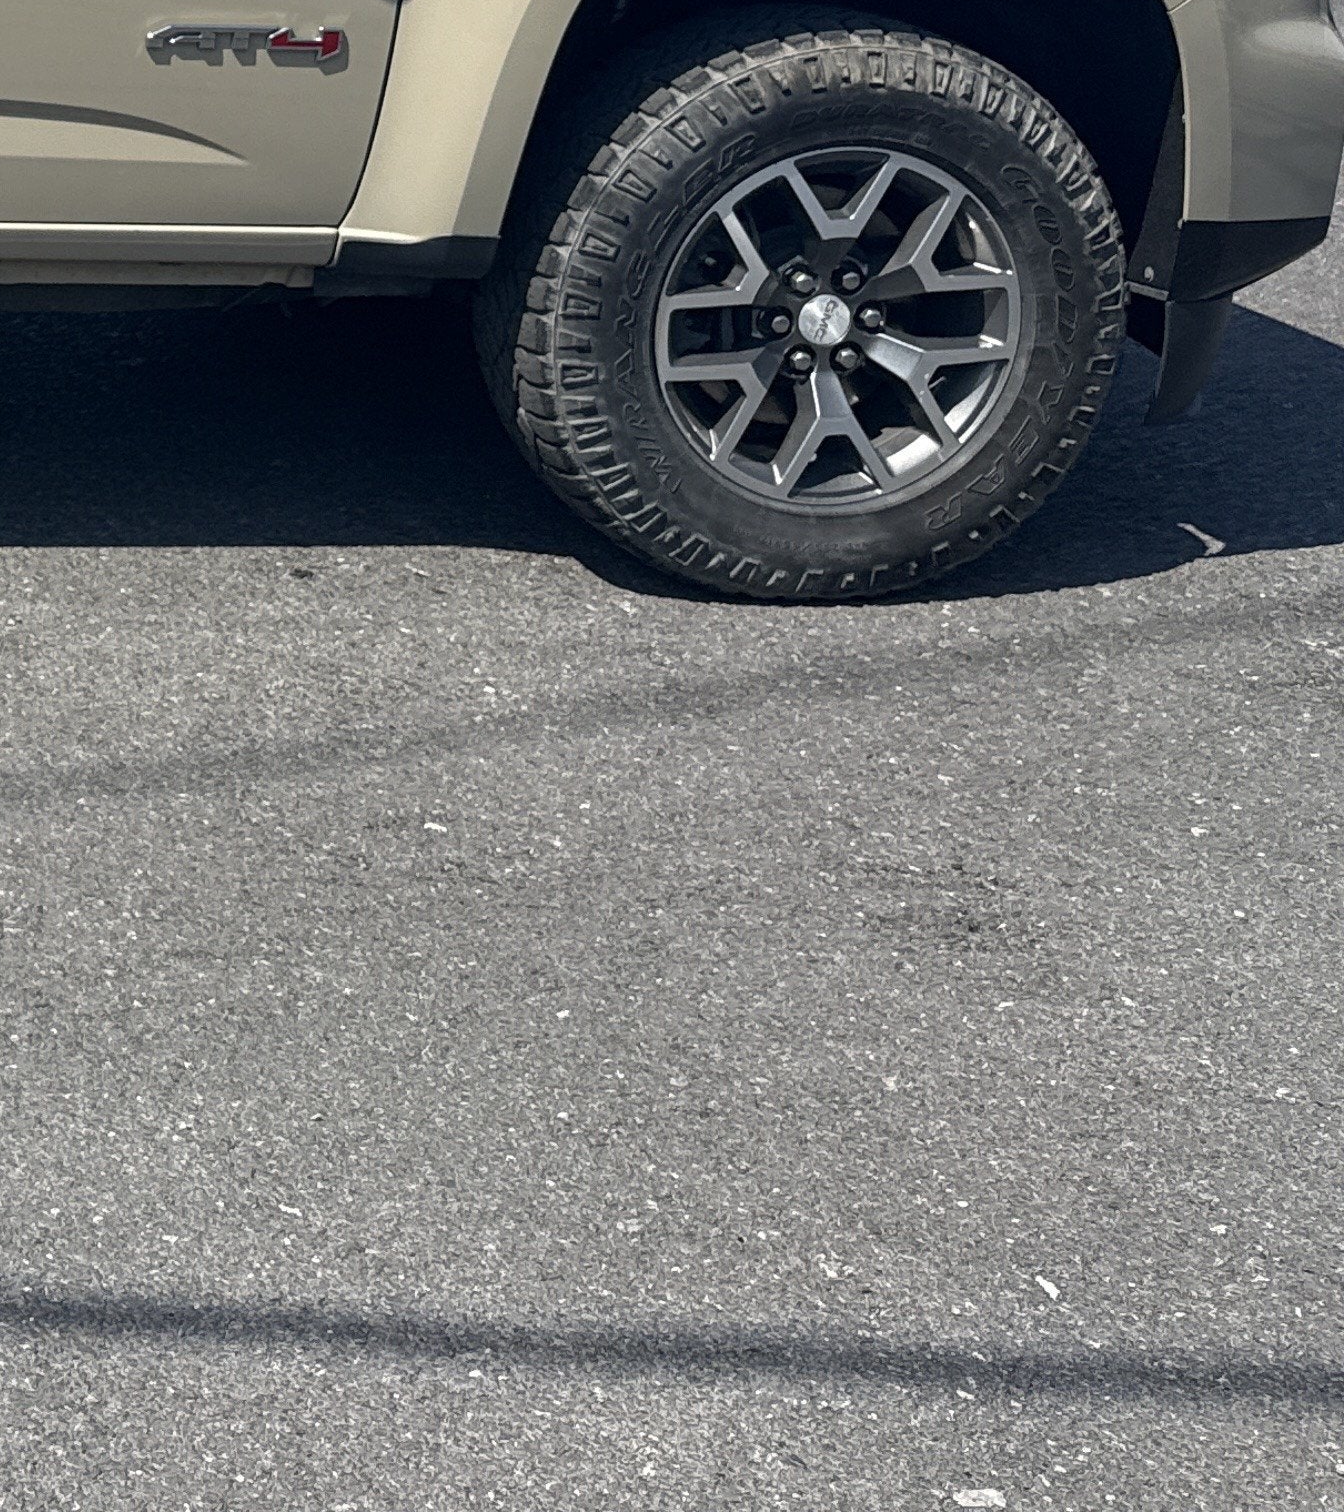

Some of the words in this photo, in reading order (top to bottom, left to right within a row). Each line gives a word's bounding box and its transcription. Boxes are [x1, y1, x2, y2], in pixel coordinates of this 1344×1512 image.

[146, 23, 343, 61] AT4
[813, 300, 839, 342] GMC
[922, 165, 1079, 531] GOODYEAR
